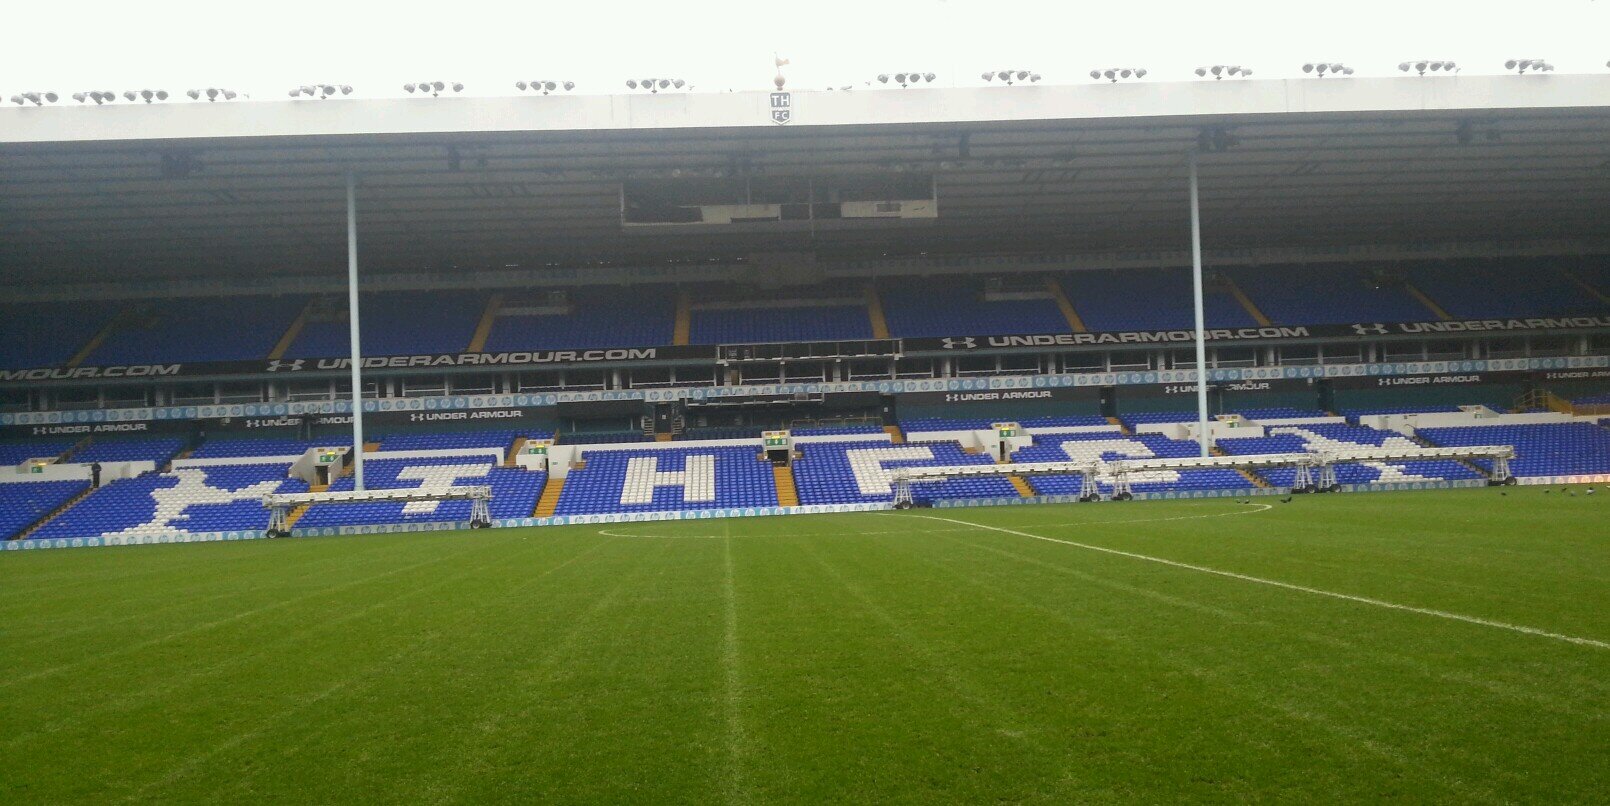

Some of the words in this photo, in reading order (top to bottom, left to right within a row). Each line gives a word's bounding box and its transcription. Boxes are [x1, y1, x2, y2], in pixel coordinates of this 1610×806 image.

[771, 95, 790, 106] TH
[774, 111, 788, 120] FC
[988, 326, 1310, 347] UNDERARMOUR.COM
[317, 348, 656, 369] UNDERARMOUR.COM
[1393, 377, 1430, 385] UNDER
[1433, 375, 1480, 384] ARMOUR
[960, 393, 999, 401] UNDER
[1002, 390, 1051, 399] ARMOUR
[426, 412, 467, 421] UNDER
[470, 410, 522, 419] ARMOUR
[49, 426, 91, 434] UNDER
[93, 423, 147, 433] ARMOUR
[620, 454, 716, 505] H
